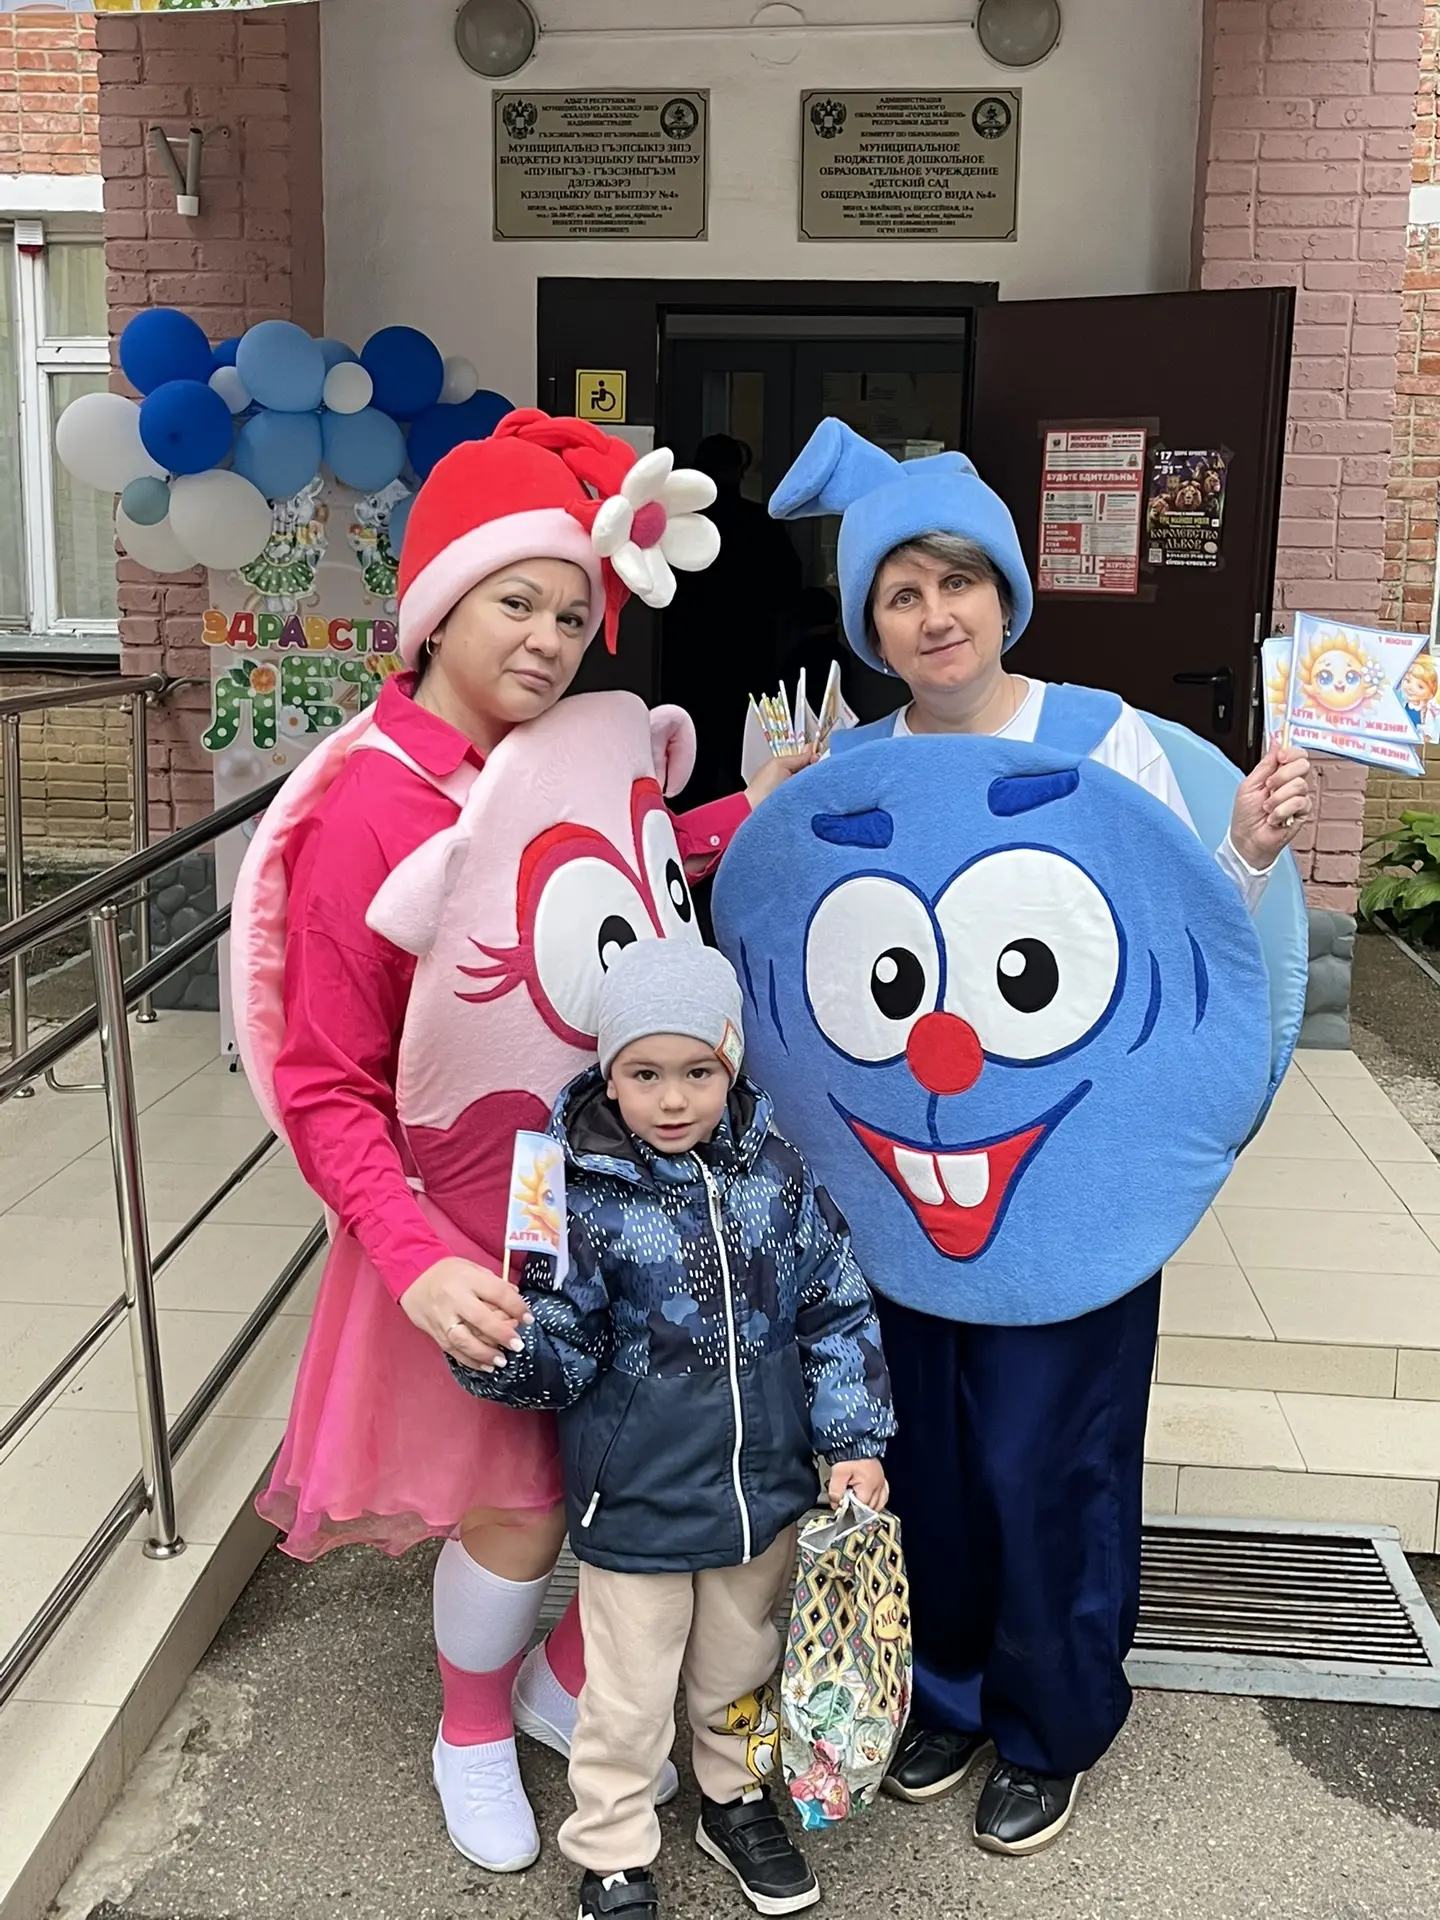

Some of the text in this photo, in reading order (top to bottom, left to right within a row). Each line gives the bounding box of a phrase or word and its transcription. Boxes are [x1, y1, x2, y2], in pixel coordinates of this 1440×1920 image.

[508, 144, 599, 154] МУНИЦИПАЛЬНЭ
[859, 143, 960, 153] МУНИЦИПАЛЬНОЕ
[500, 155, 561, 165] БЮДЖЕТНЭ
[834, 155, 984, 165] БЮДЖЕТНОЕ ДОШКОЛЬНОЕ
[819, 167, 999, 176] ОБРАЗОВАТЕЛЬНОЕ УЧРЕЖДЕНИЕ
[869, 178, 949, 188] «ДЕТСКИЙ САД
[821, 191, 942, 200] ОБЩЕРАЗВИВАЮЩЕГО
[945, 191, 973, 200] ВИДА
[1160, 451, 1172, 460] 17
[1161, 466, 1173, 474] 31
[1047, 473, 1138, 481] БУДЬТЕ БДИТЕЛЬНЫ,
[1150, 528, 1219, 539] КОРОЛЕВСТВО
[1165, 538, 1202, 549] ЛЬВОВ
[1082, 556, 1105, 573] НЕ
[202, 609, 398, 653] ЗДРАВСТВ
[1325, 712, 1361, 727] ЦВЕТЫ
[1293, 728, 1318, 739] ДЕТИ
[1331, 735, 1366, 750] ЦВЕТЫ
[509, 1230, 539, 1241] ДЕТИ
